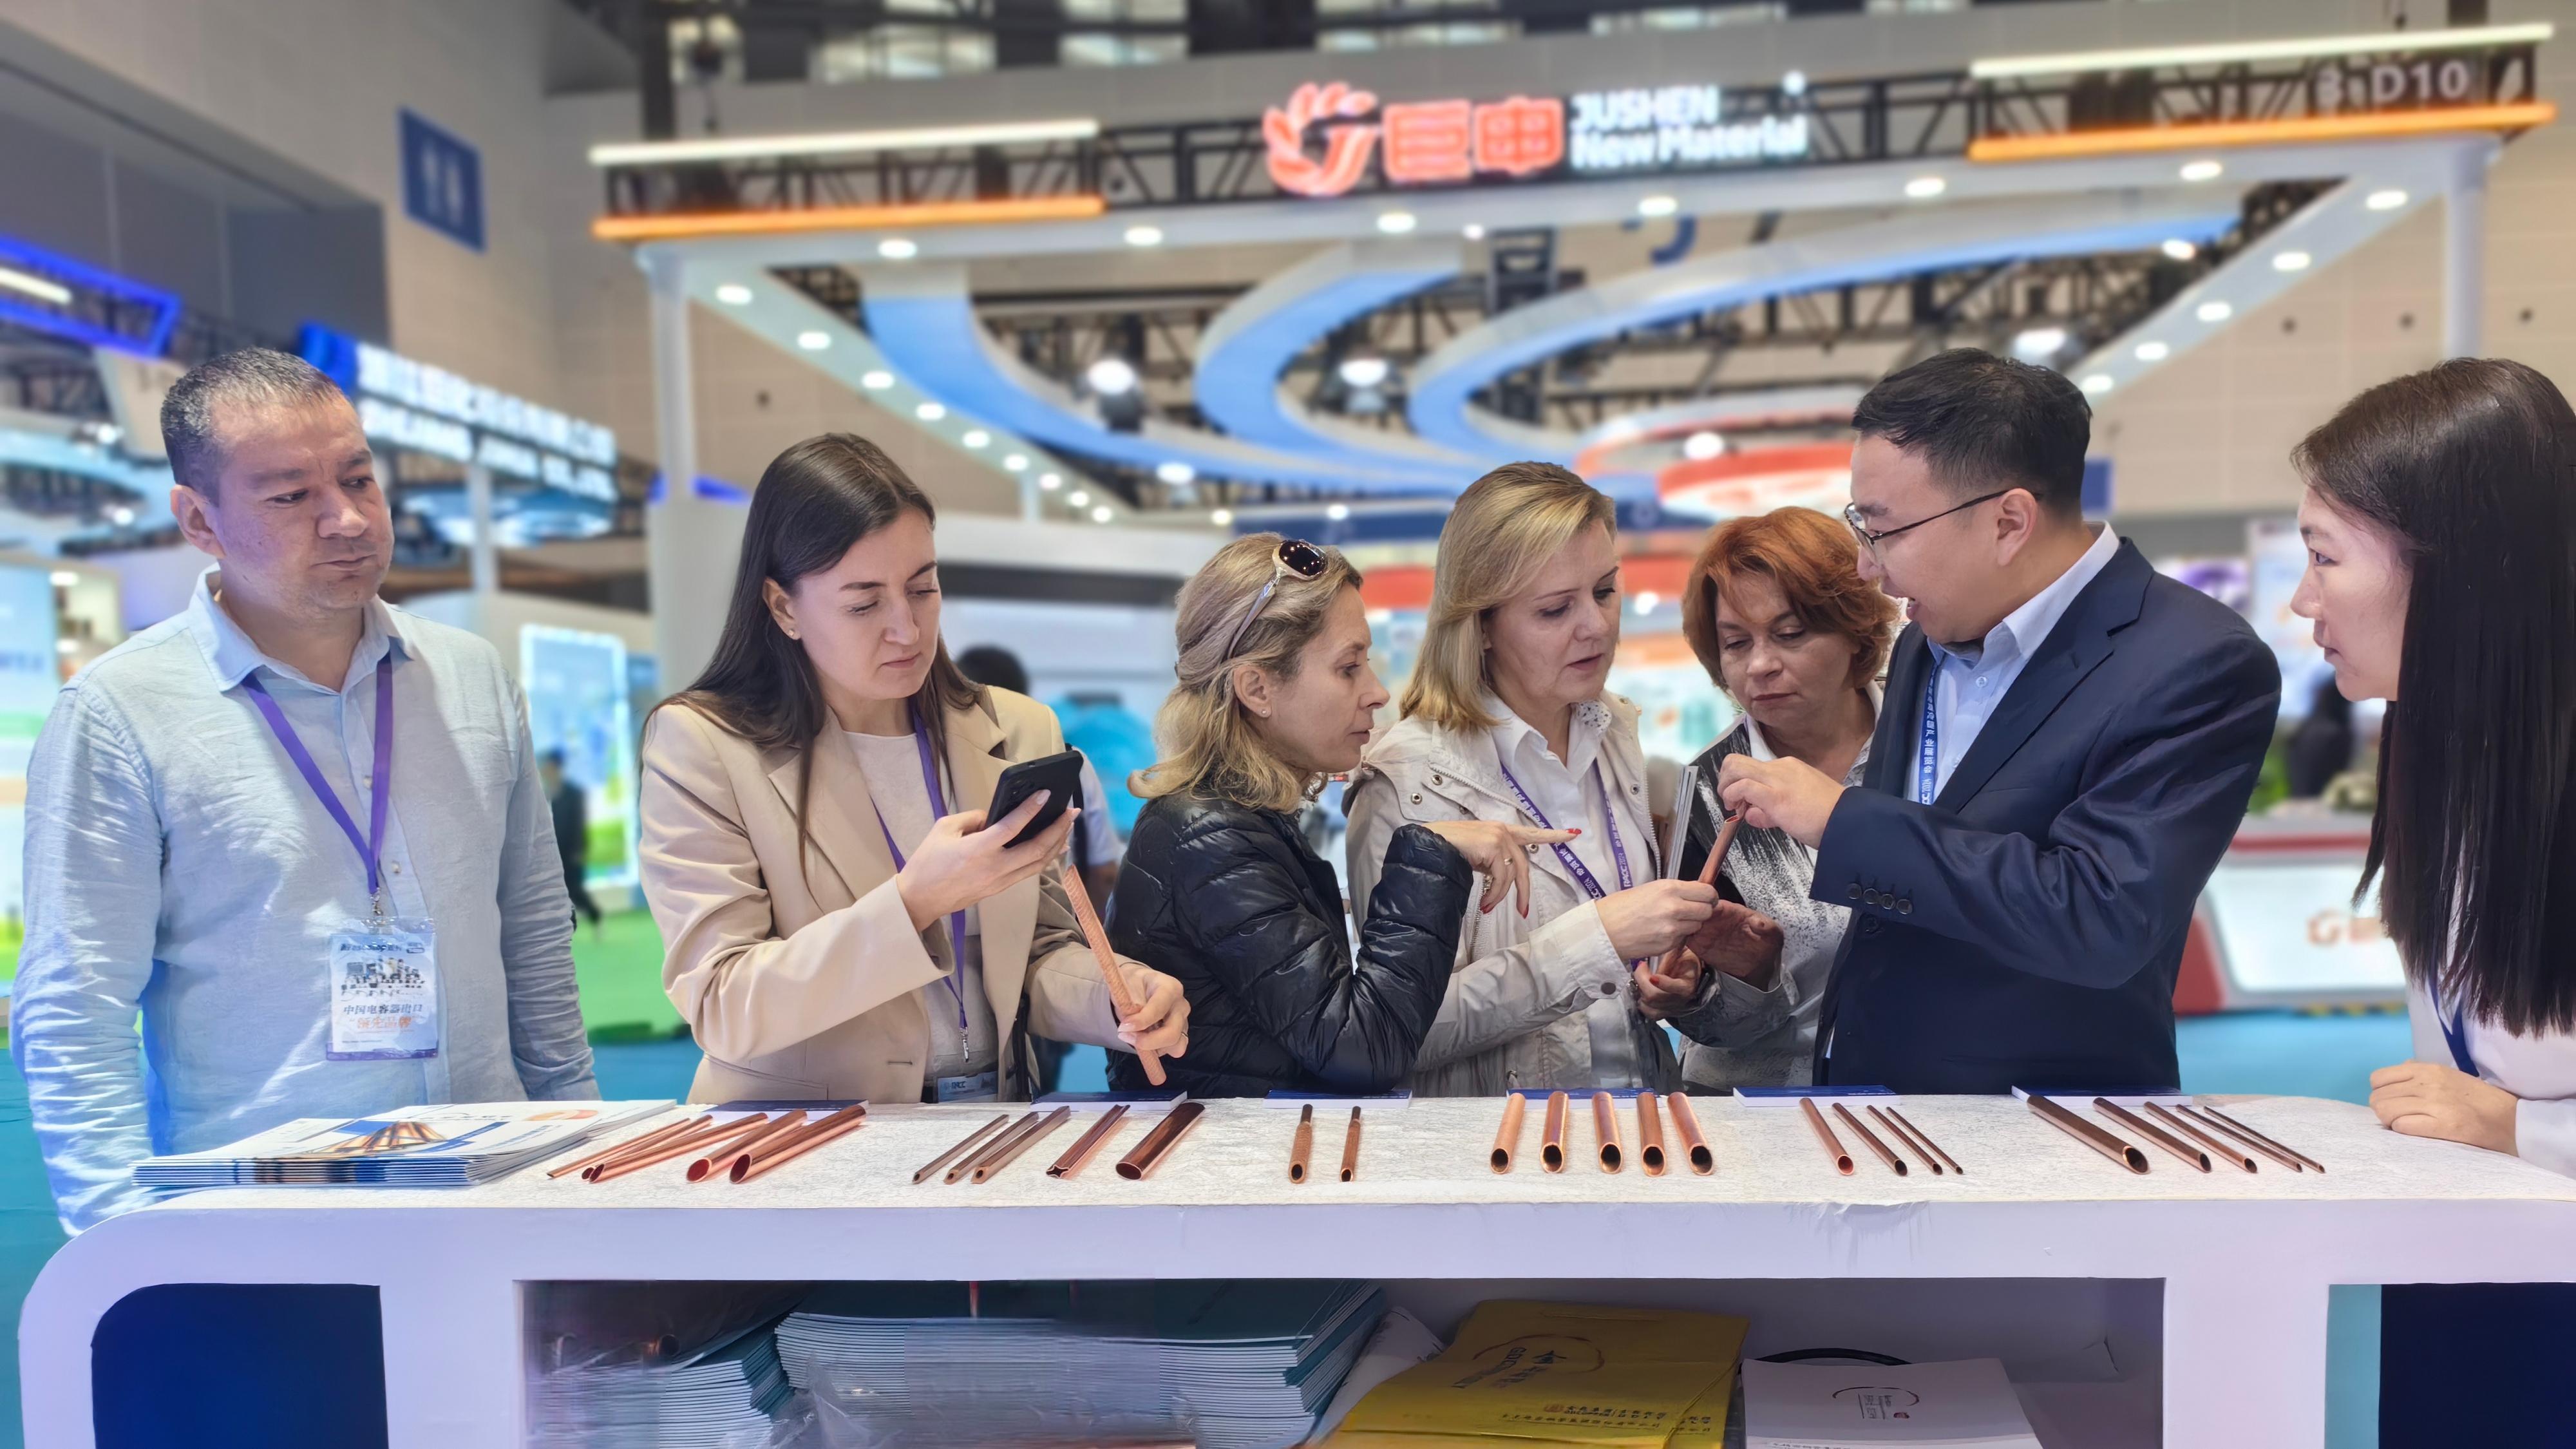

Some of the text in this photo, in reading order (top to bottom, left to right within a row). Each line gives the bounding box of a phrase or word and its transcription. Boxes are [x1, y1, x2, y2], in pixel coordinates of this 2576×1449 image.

[1572, 86, 1719, 129] JUSHEN
[1383, 97, 1563, 182] 巨申
[1572, 115, 1807, 169] New Material
